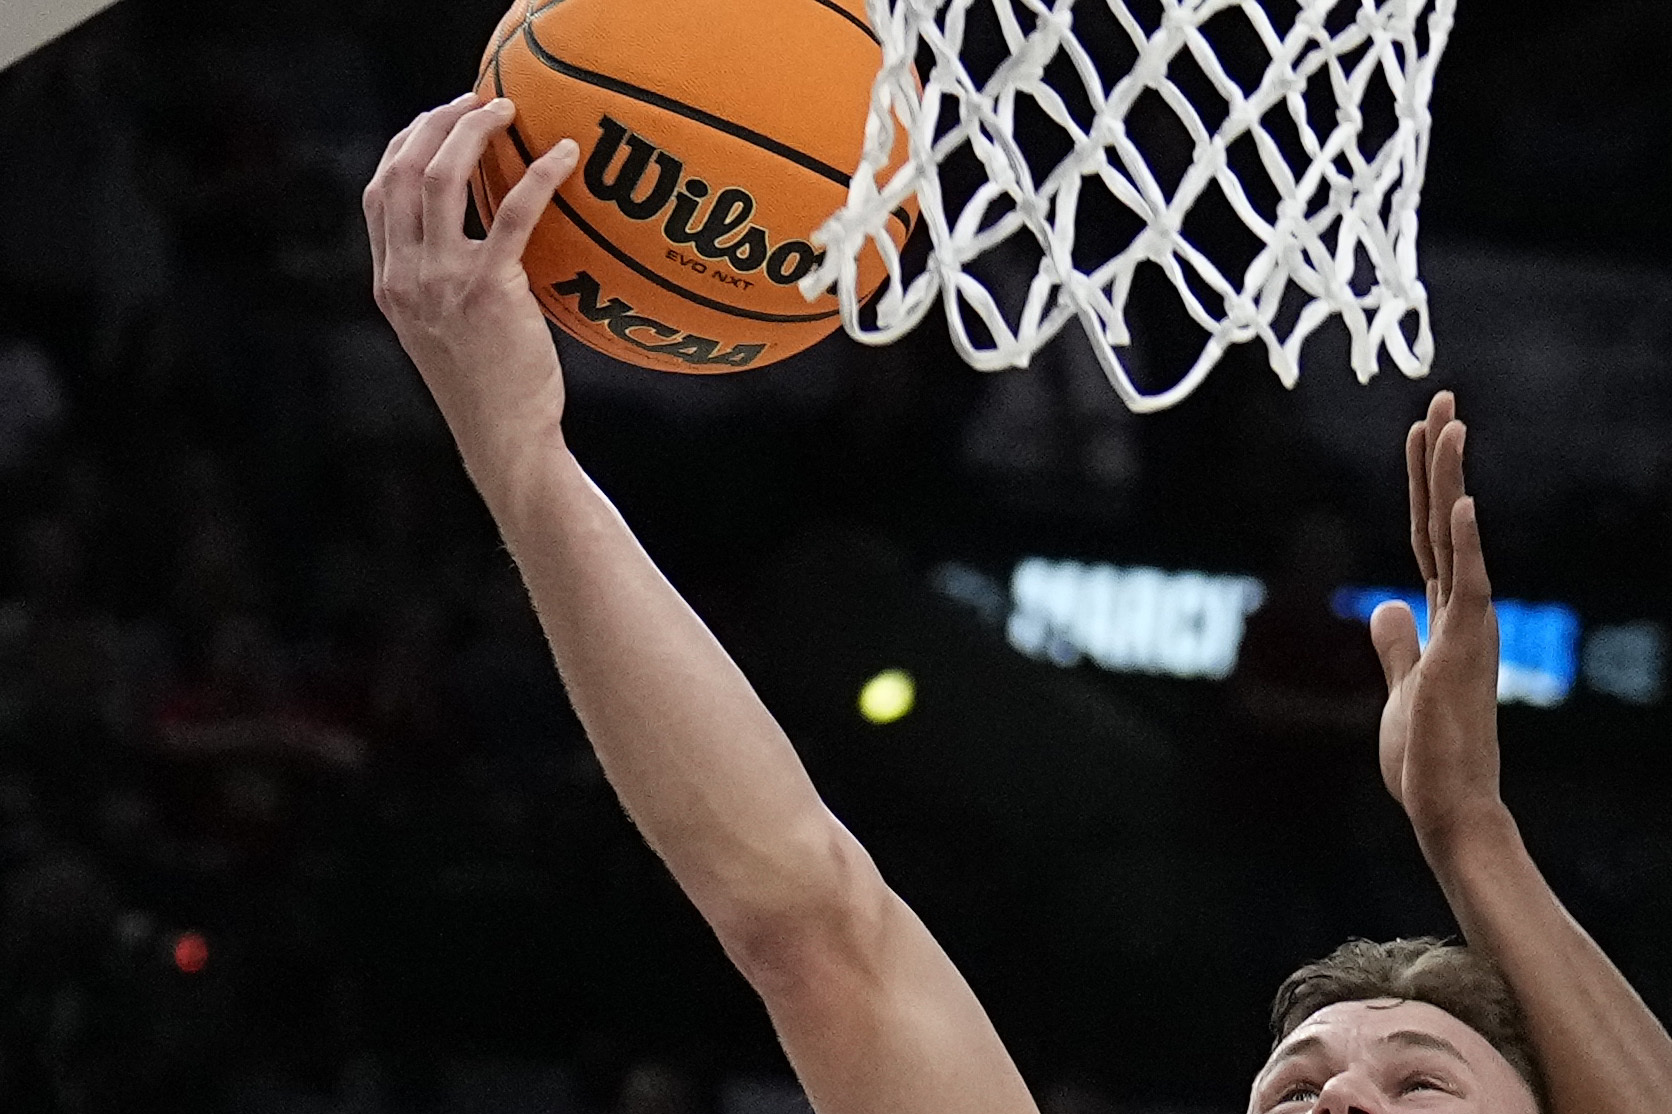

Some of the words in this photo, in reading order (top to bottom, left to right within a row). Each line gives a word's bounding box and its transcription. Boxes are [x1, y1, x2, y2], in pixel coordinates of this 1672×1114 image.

[583, 113, 834, 294] Wilso
[549, 269, 769, 367] NCAA
[664, 248, 708, 275] EVO
[711, 269, 755, 291] NXT
